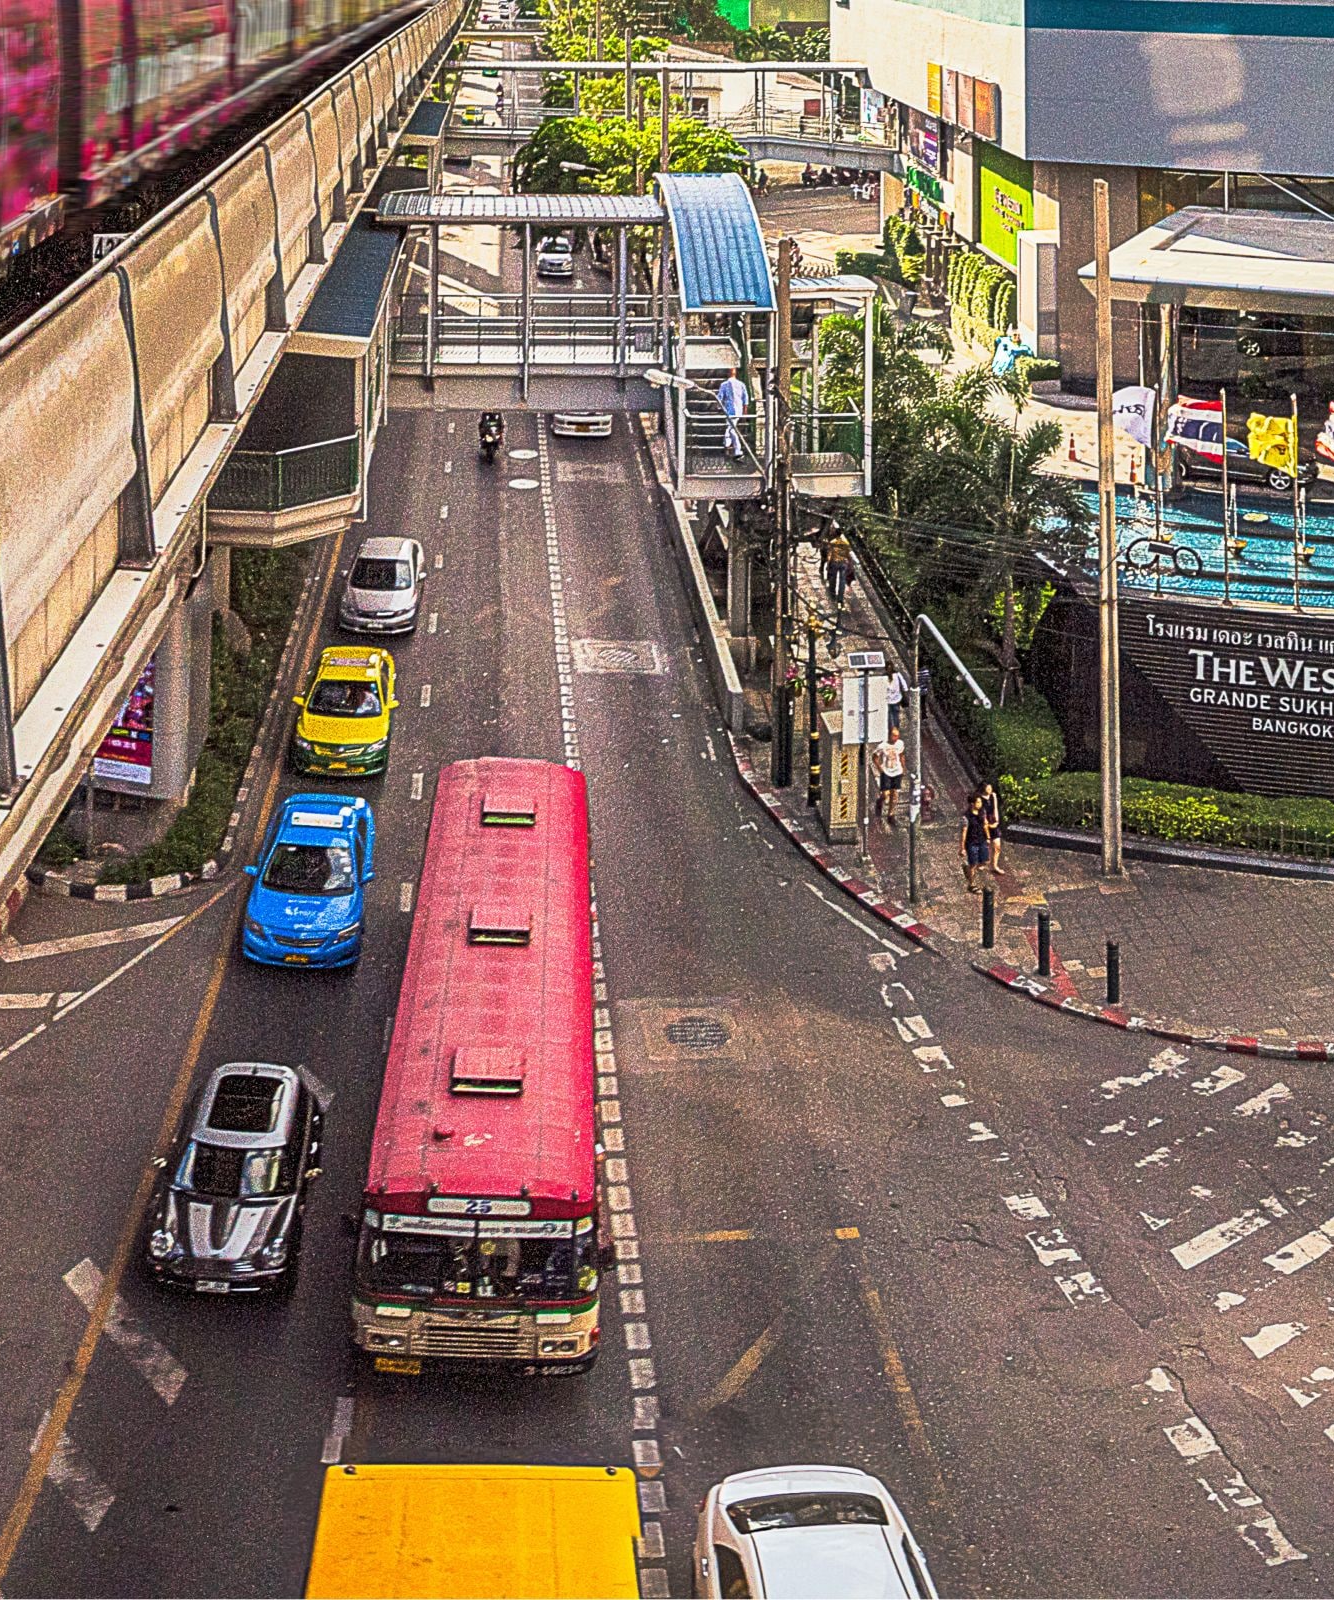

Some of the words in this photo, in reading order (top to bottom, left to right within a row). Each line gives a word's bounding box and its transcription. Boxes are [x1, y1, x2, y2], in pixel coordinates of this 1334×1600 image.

[94, 237, 126, 260] 42
[1146, 614, 1208, 642] โรงแรม
[1213, 627, 1252, 647] เดอะ
[1257, 631, 1313, 653] เวสทิน
[1188, 648, 1257, 686] THE
[1189, 687, 1271, 711] GRANDE
[1252, 717, 1333, 739] BANGKOK
[466, 1200, 492, 1214] 25
